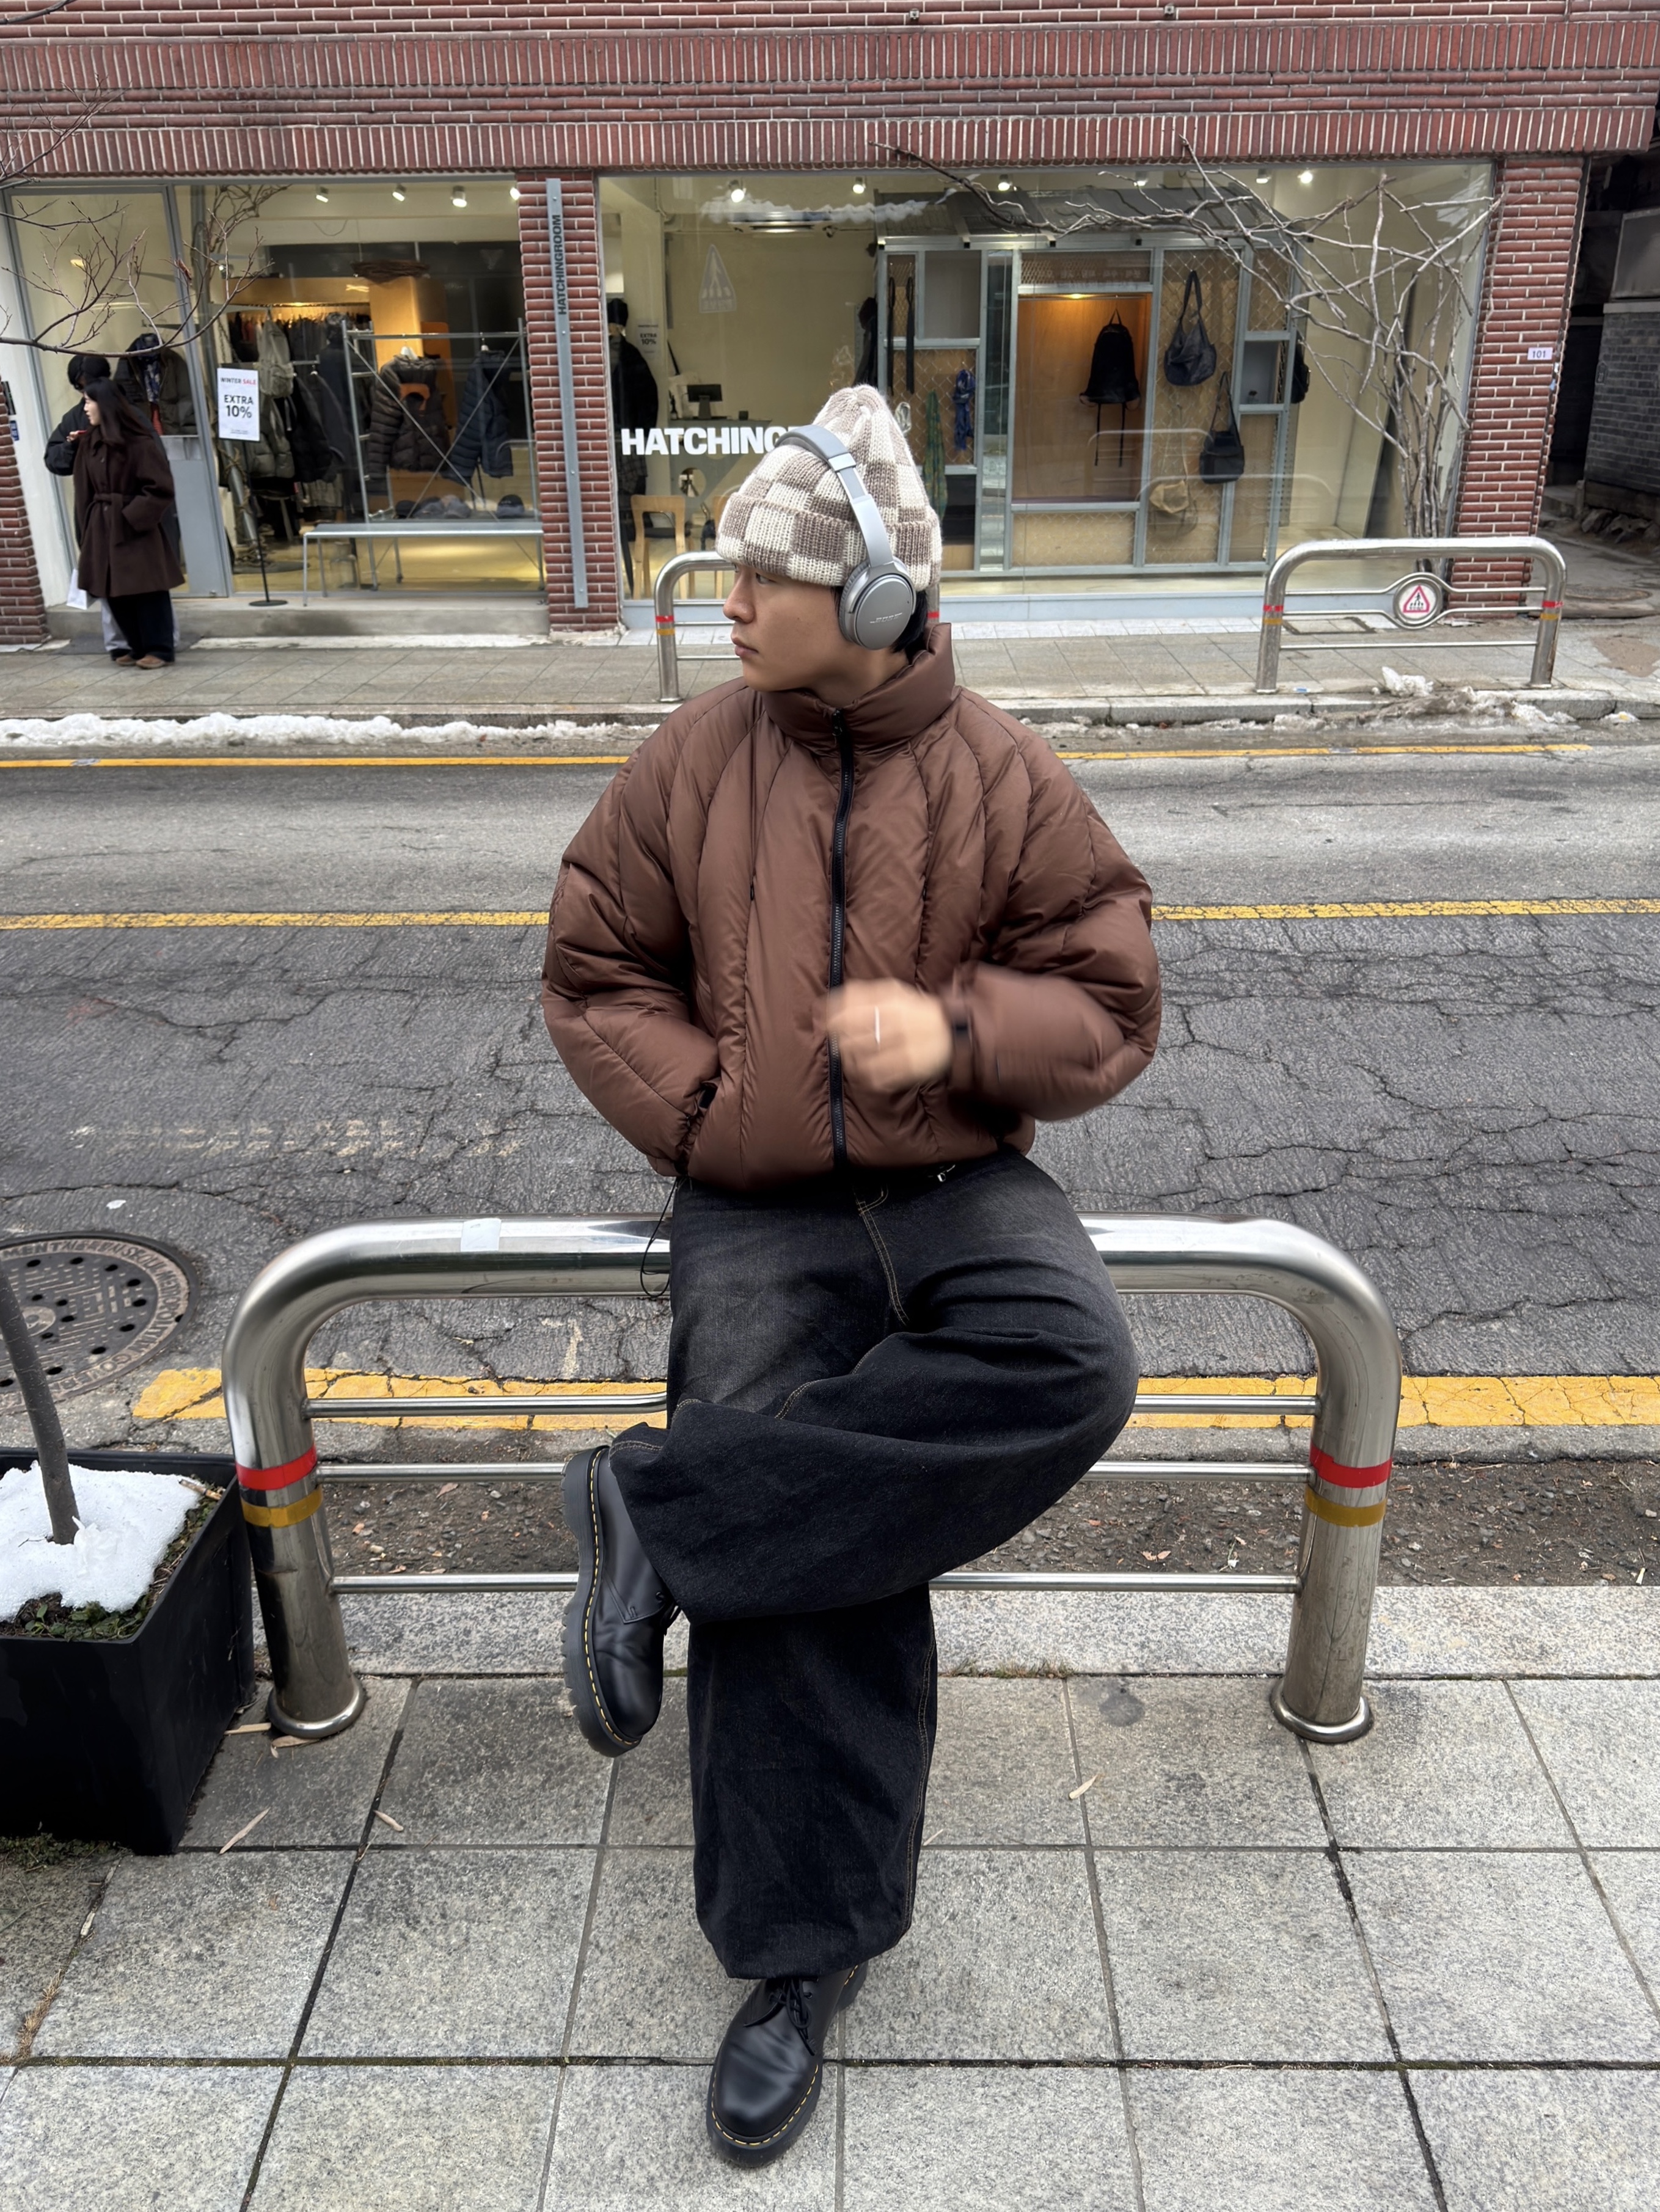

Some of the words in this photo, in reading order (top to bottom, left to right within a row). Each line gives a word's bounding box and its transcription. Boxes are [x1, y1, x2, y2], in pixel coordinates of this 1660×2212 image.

[552, 215, 567, 315] HATCHINGROOM
[224, 395, 254, 404] EXTRA
[227, 405, 252, 418] 10%
[621, 426, 800, 455] HATCHING
[121, 1246, 169, 1274] SEOUL
